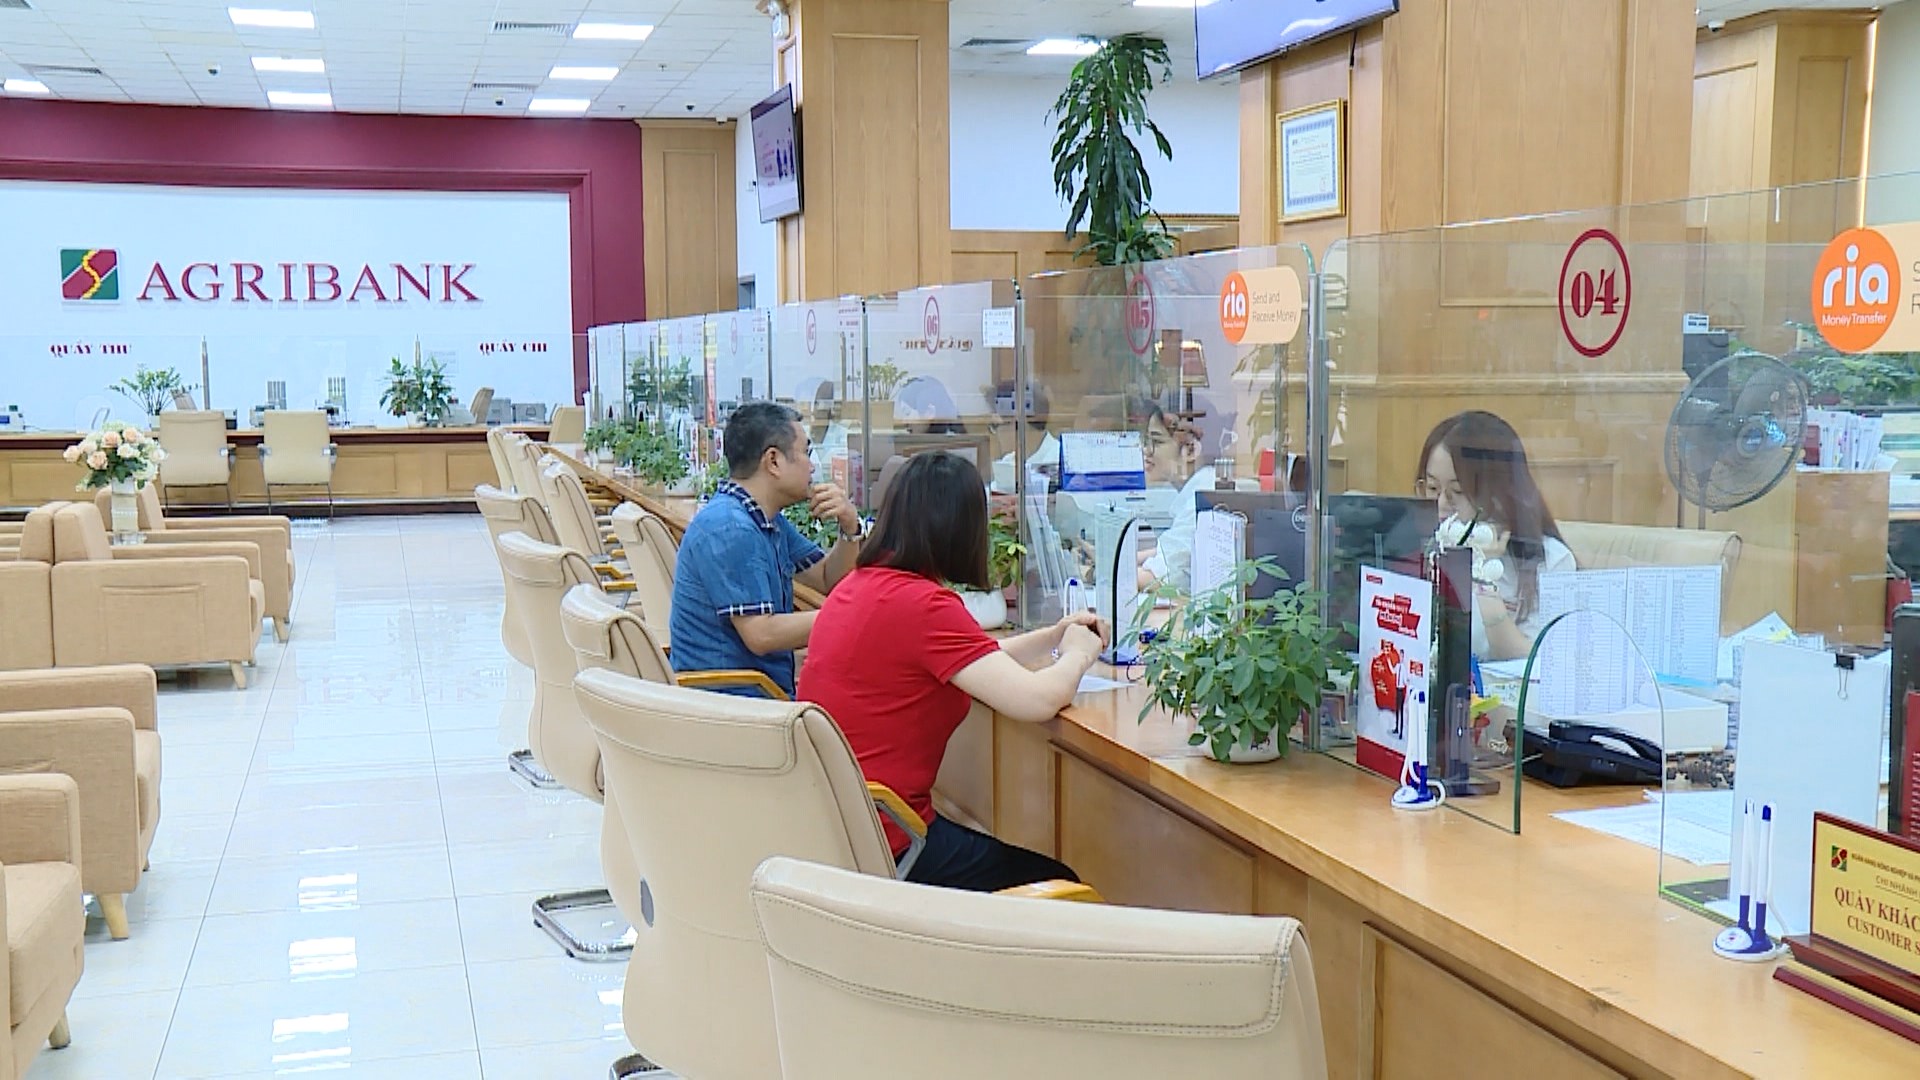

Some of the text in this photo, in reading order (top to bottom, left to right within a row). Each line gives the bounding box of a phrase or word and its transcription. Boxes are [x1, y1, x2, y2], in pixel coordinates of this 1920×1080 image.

[136, 261, 484, 304] AGRIBANK
[1570, 268, 1620, 319] 04
[1822, 244, 1889, 308] ria
[1130, 301, 1150, 329] 05
[1223, 279, 1246, 319] ria
[1252, 291, 1280, 304] Send and
[1276, 309, 1298, 323] Money
[1822, 311, 1887, 328] Money Transfer
[1847, 915, 1912, 951] CUSTOMER
